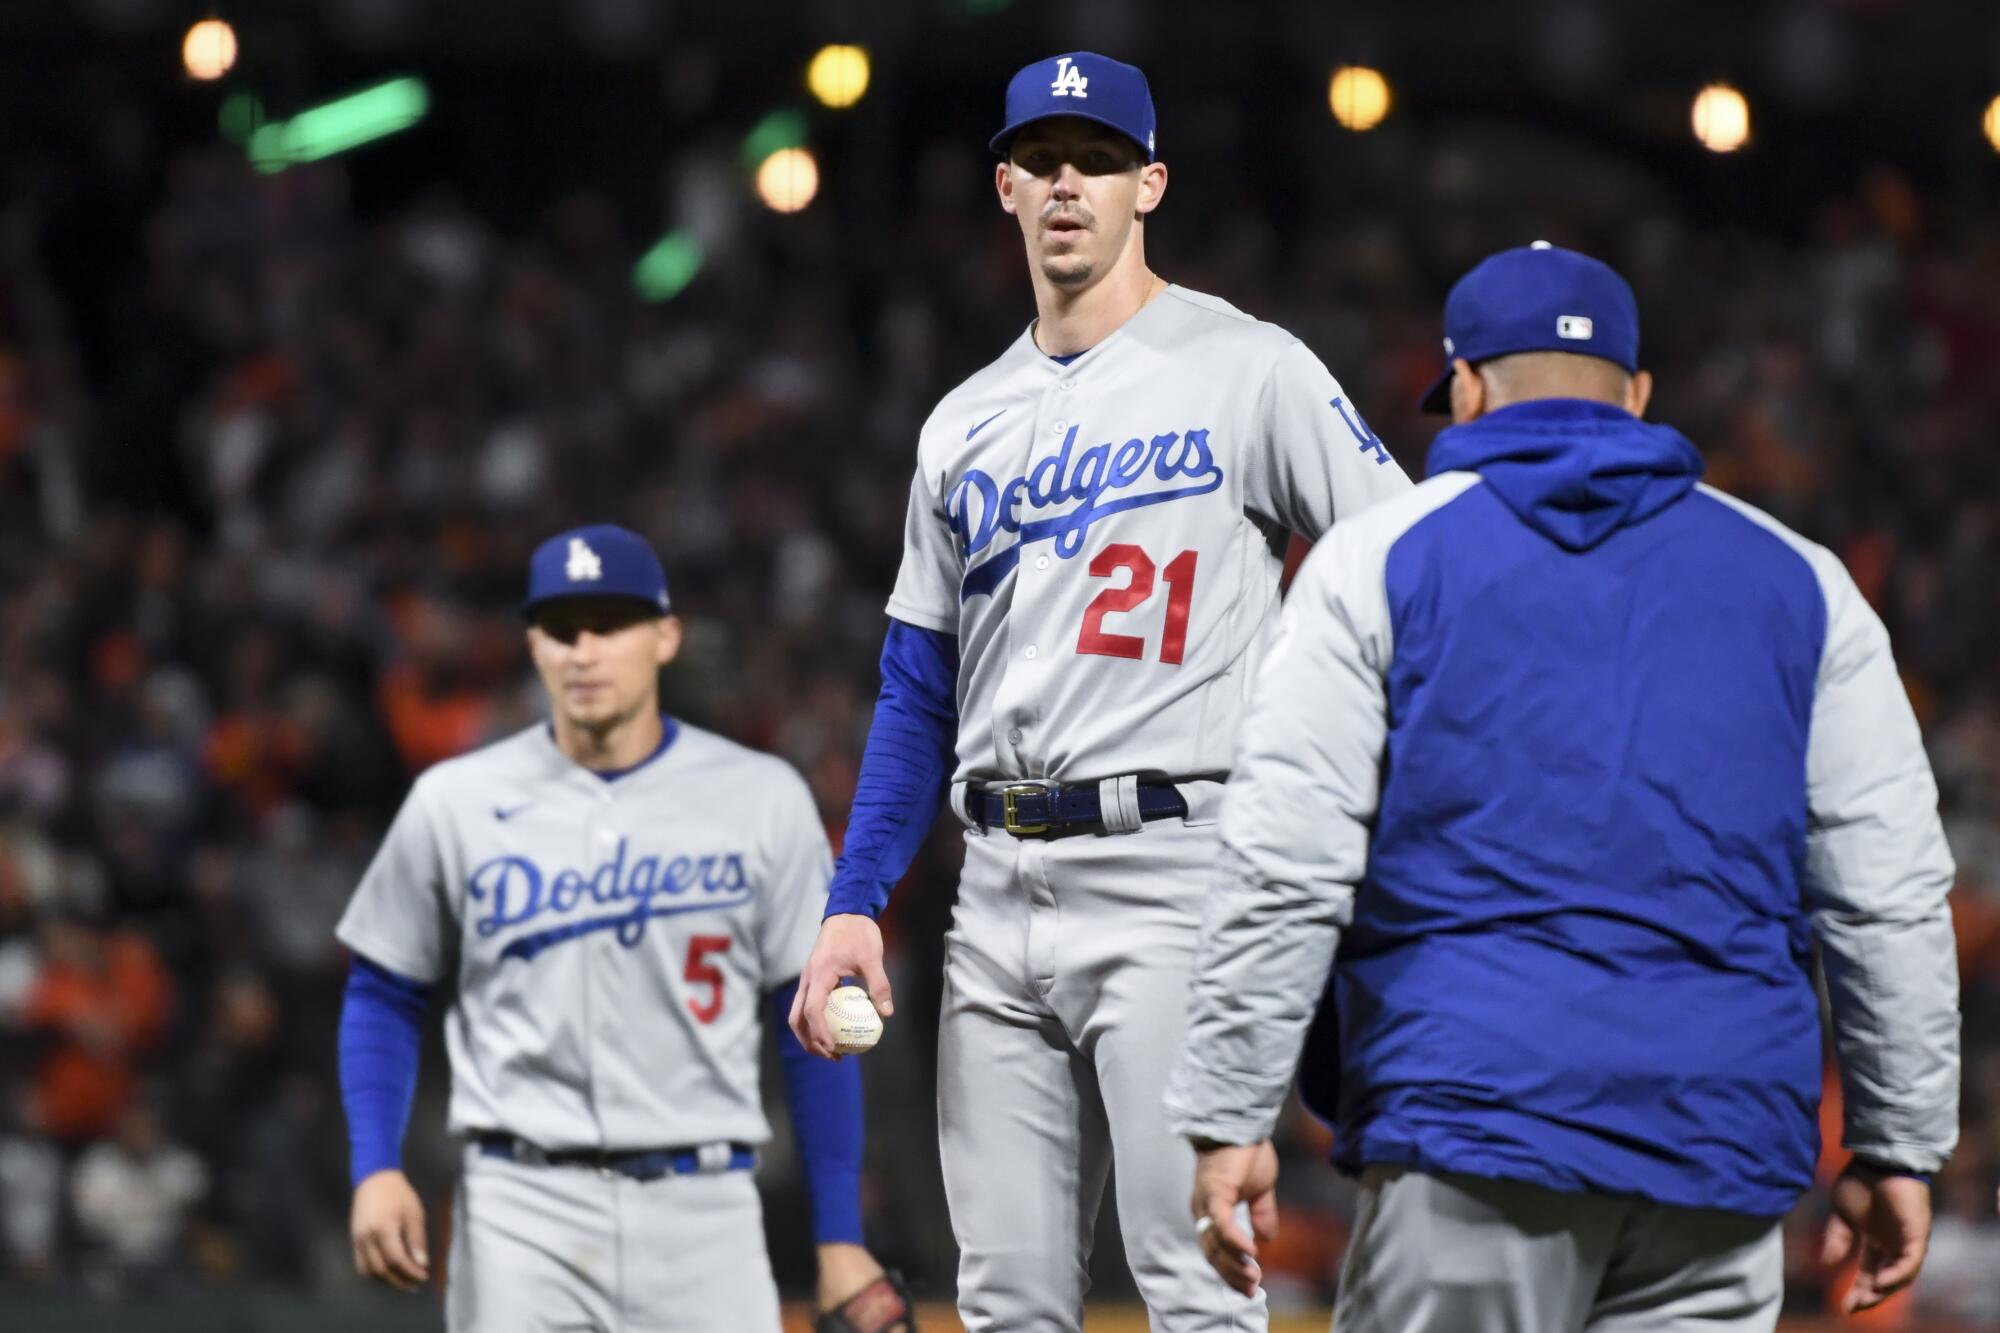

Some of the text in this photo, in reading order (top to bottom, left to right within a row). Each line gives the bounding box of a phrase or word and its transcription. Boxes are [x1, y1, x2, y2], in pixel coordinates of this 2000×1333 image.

[1051, 57, 1088, 98] LA
[945, 424, 1223, 560] Dodgers
[1076, 543, 1198, 665] 21
[467, 834, 753, 949] Dodgers
[683, 934, 733, 1025] 5
